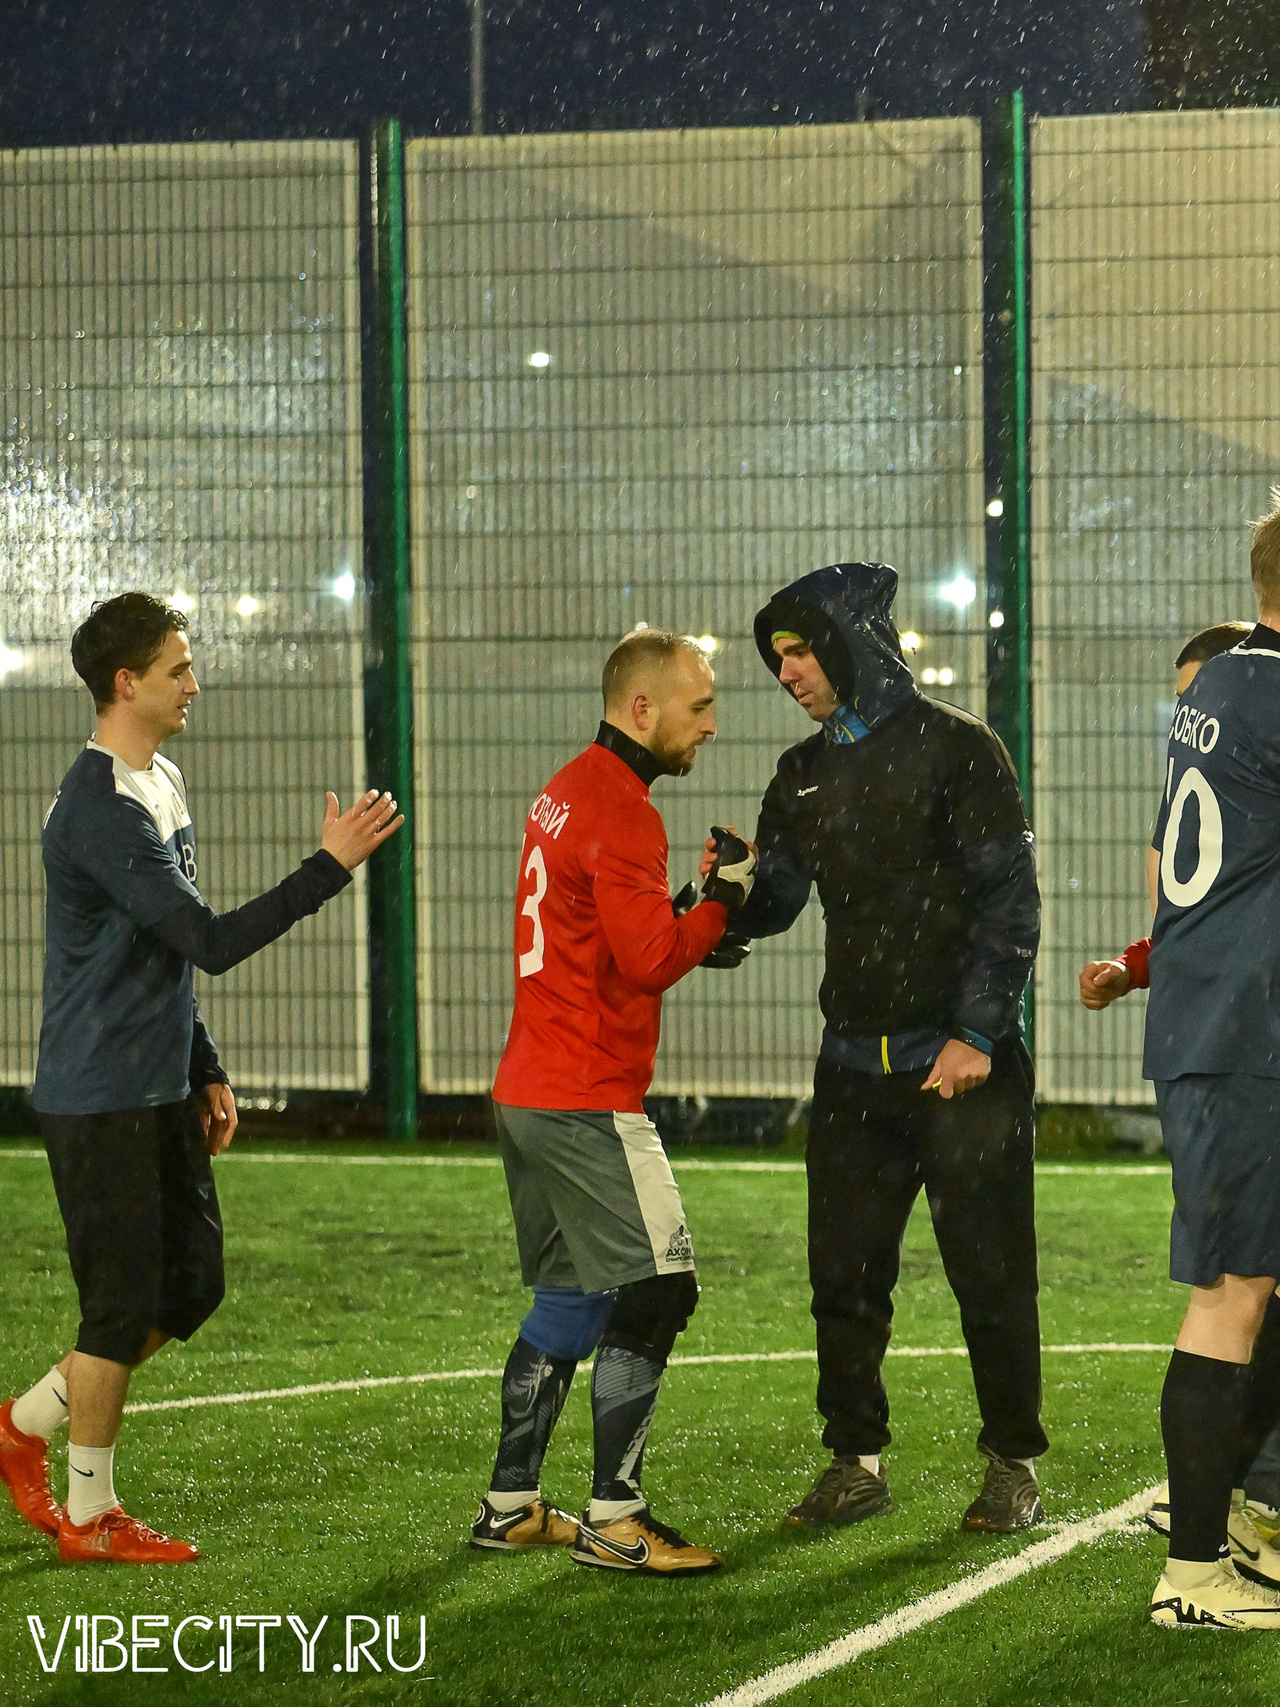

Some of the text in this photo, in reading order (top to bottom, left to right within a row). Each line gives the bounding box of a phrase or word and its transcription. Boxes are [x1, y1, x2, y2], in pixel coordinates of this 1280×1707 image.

[1169, 705, 1220, 754] ОБКО
[522, 832, 548, 978] 3
[666, 1247, 692, 1257] AXON
